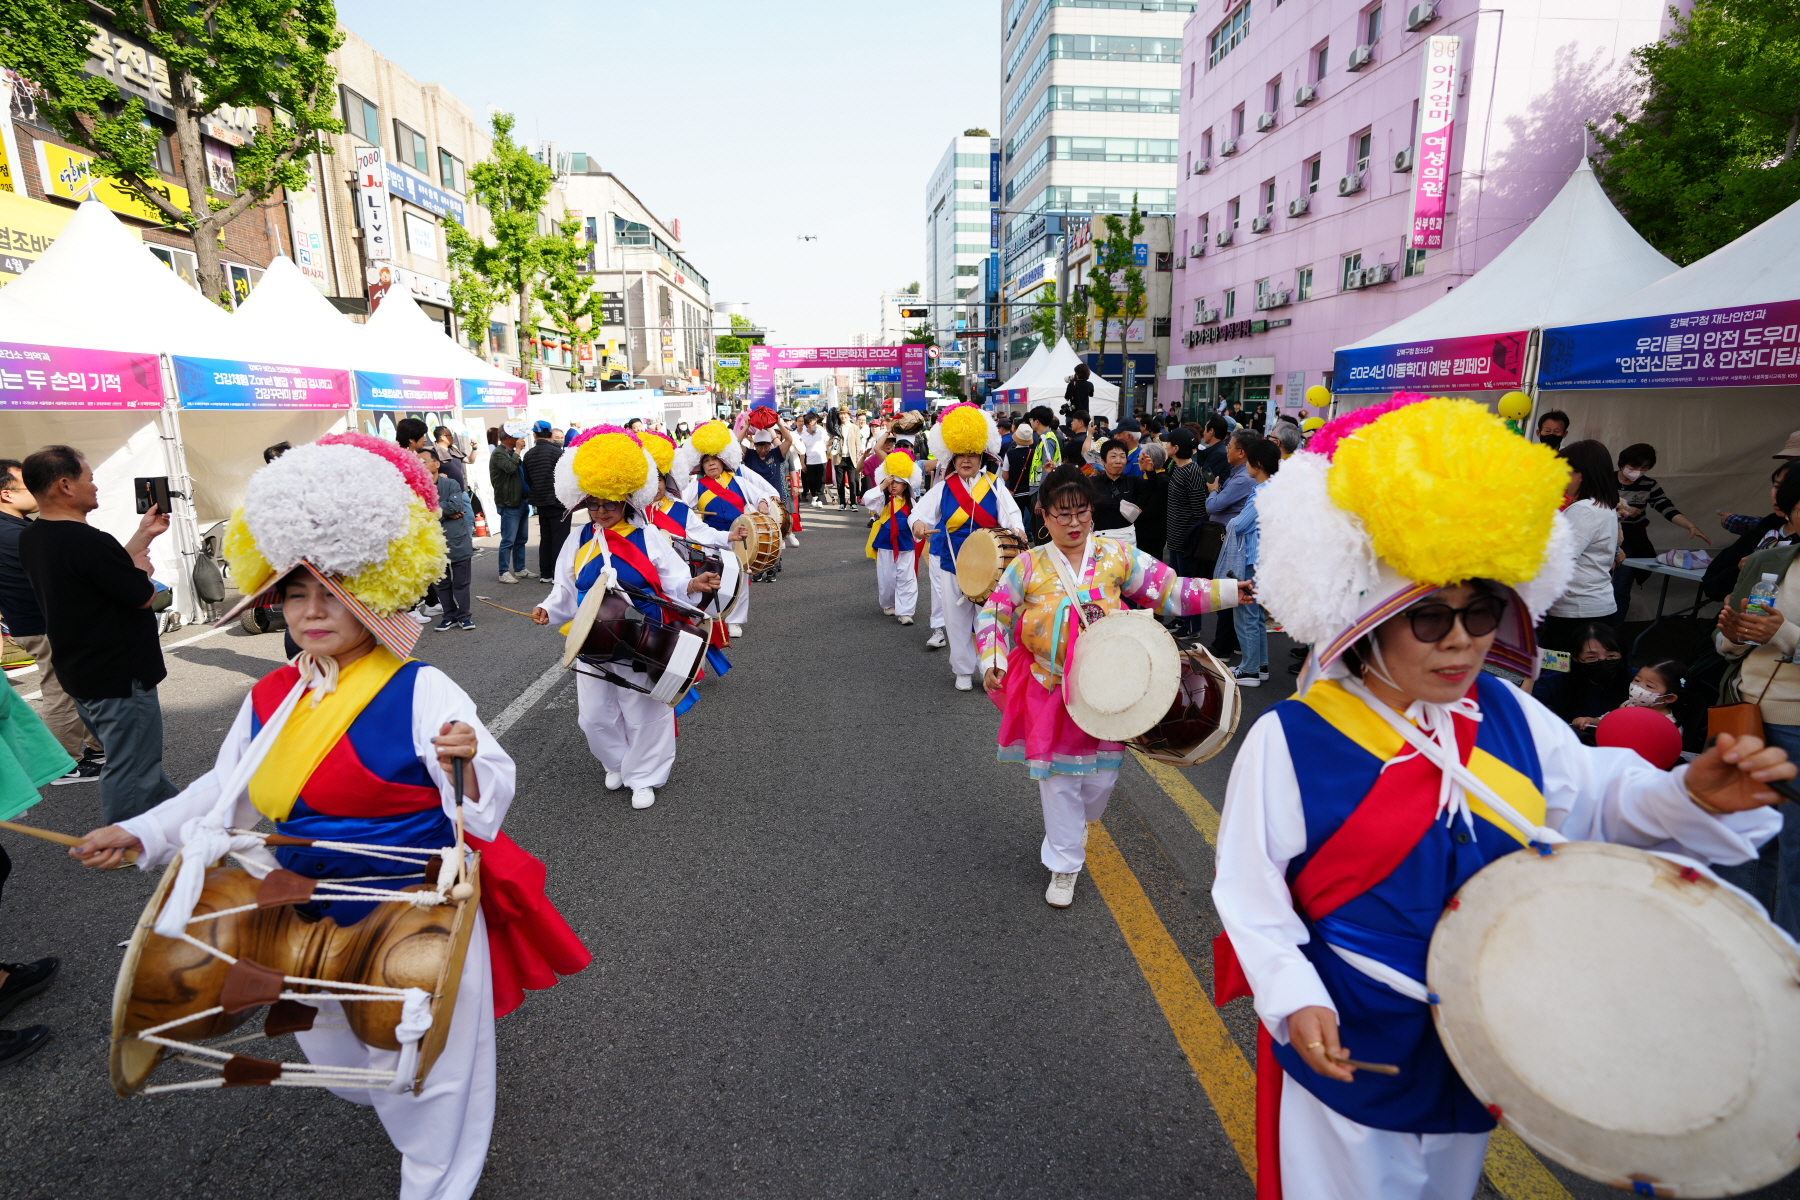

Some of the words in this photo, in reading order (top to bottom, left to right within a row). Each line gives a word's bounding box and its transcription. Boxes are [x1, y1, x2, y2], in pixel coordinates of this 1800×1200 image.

[1428, 64, 1457, 122] 아가엄마
[357, 150, 379, 170] 7080
[1420, 135, 1447, 198] 여성의원
[362, 174, 383, 188] Ju
[367, 195, 384, 244] Live
[1415, 216, 1443, 231] 산부인과
[375, 249, 385, 257] 2F
[302, 266, 324, 280] 마사지
[1670, 315, 1709, 329] 강북구청
[1711, 309, 1766, 324] 재난안전과
[663, 336, 673, 345] PC
[1636, 333, 1700, 353] 우리들의
[1703, 329, 1740, 350] 안전
[24, 351, 51, 362] 의약과
[819, 348, 867, 359] 국민문화제
[869, 348, 898, 358] 2024
[1616, 353, 1700, 373] "안전신문고
[1702, 352, 1715, 368] &
[1719, 346, 1800, 369] 안전디딤
[1350, 364, 1385, 379] 2024년
[1386, 361, 1426, 379] 아동학대
[1428, 359, 1451, 377] 예방
[1452, 357, 1491, 375] 캠페인
[0, 368, 25, 390] 는
[26, 370, 47, 391] 두
[50, 371, 87, 392] 손의
[88, 373, 122, 393] 기적
[213, 372, 249, 386] 건강체험
[308, 378, 333, 389] 검사하고
[255, 388, 291, 400] 건강꾸러미
